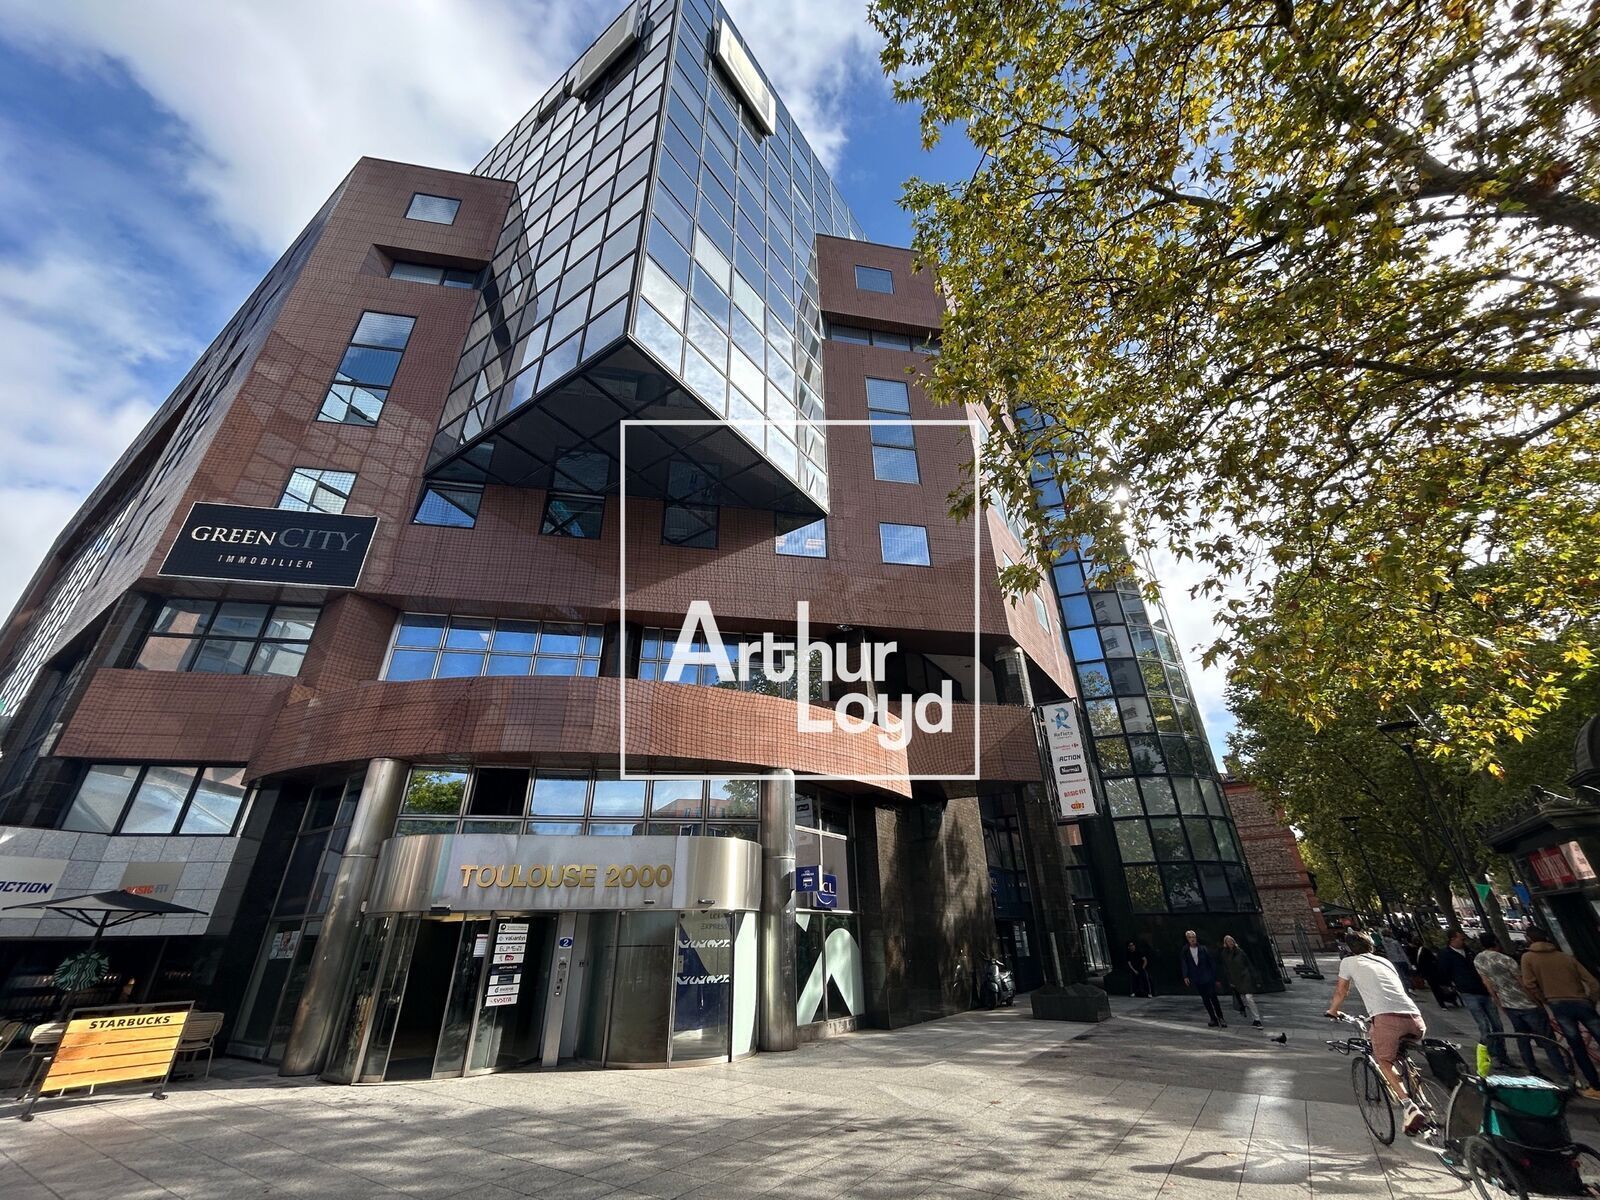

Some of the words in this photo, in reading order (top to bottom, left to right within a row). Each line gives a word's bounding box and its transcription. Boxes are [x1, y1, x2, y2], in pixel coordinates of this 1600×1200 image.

[218, 554, 313, 569] IMMOBILIER
[1060, 754, 1081, 762] ACTION
[460, 864, 597, 888] TOULOUSE
[604, 864, 673, 888] 2000
[563, 939, 569, 947] 2
[89, 1015, 170, 1030] STARBUCKS
